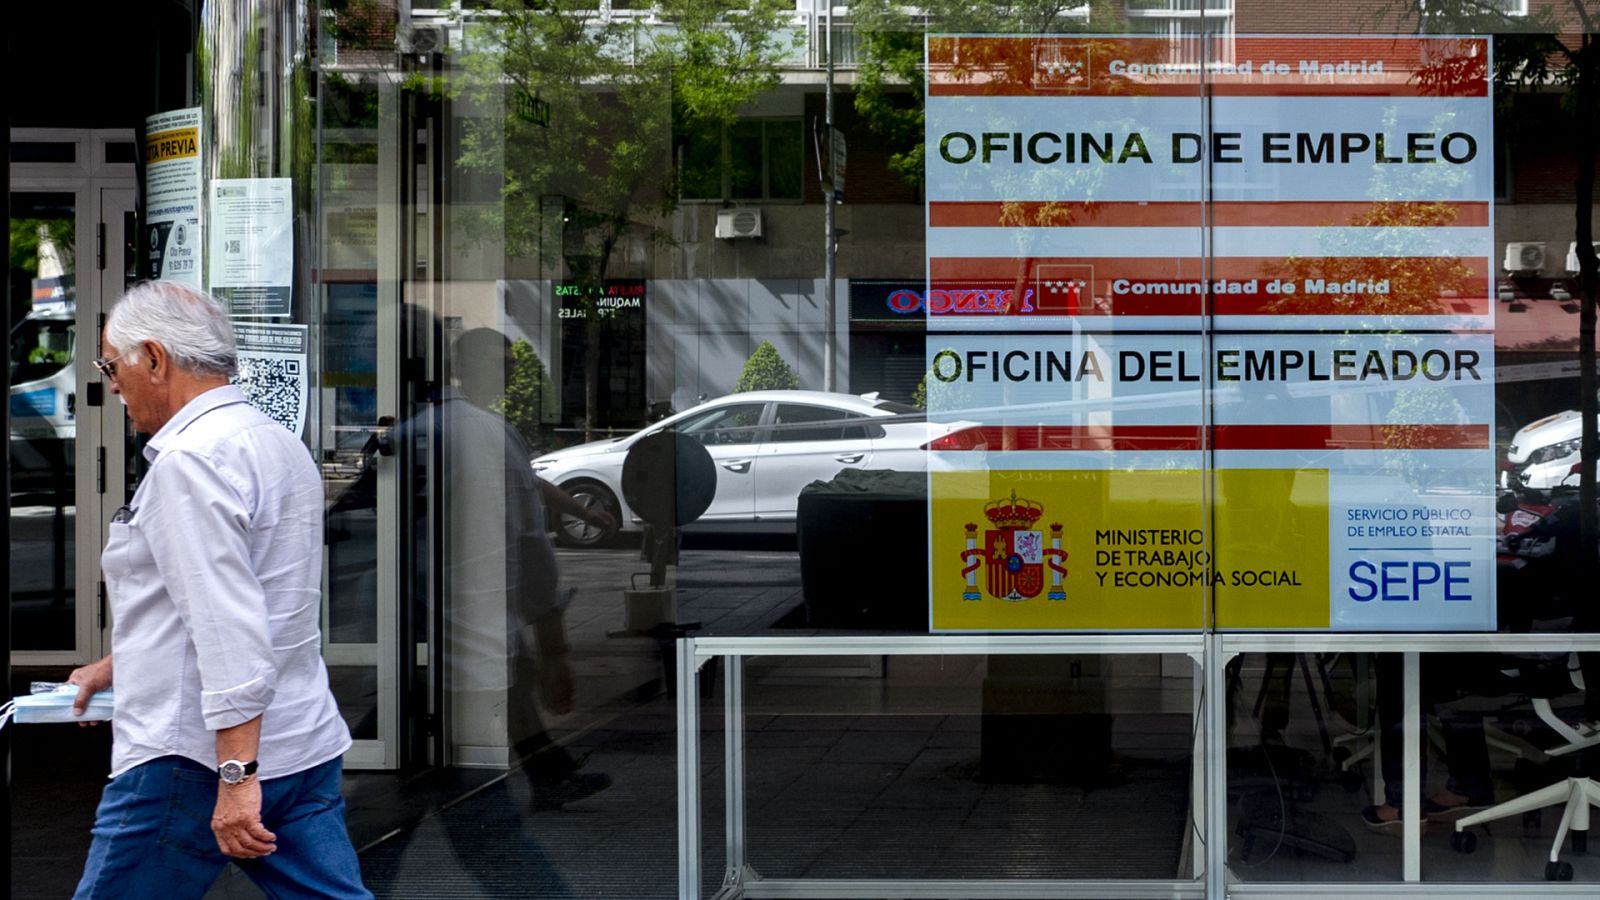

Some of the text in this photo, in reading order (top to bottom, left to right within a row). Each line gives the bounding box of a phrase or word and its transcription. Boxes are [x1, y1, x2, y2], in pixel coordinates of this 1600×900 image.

[1108, 59, 1384, 76] Comunidad de Madrid
[160, 138, 197, 158] PREVIA
[939, 131, 1479, 165] OFICINA DE EMPLEO
[1112, 278, 1391, 295] Comunidad de Madrid
[932, 350, 1106, 383] OFICINA
[1118, 349, 1201, 382] DEL
[1216, 349, 1482, 382] EMPLEADOR
[1347, 506, 1472, 521] SERVICIO PÚBLICO
[1095, 529, 1204, 546] MINISTERIO
[1347, 525, 1472, 537] DE EMPLEO ESTATAL
[1096, 550, 1211, 571] DE TRABAJO
[1095, 567, 1302, 588] Y ECONOMÍA SOCIAL
[1348, 560, 1473, 602] SEPE
